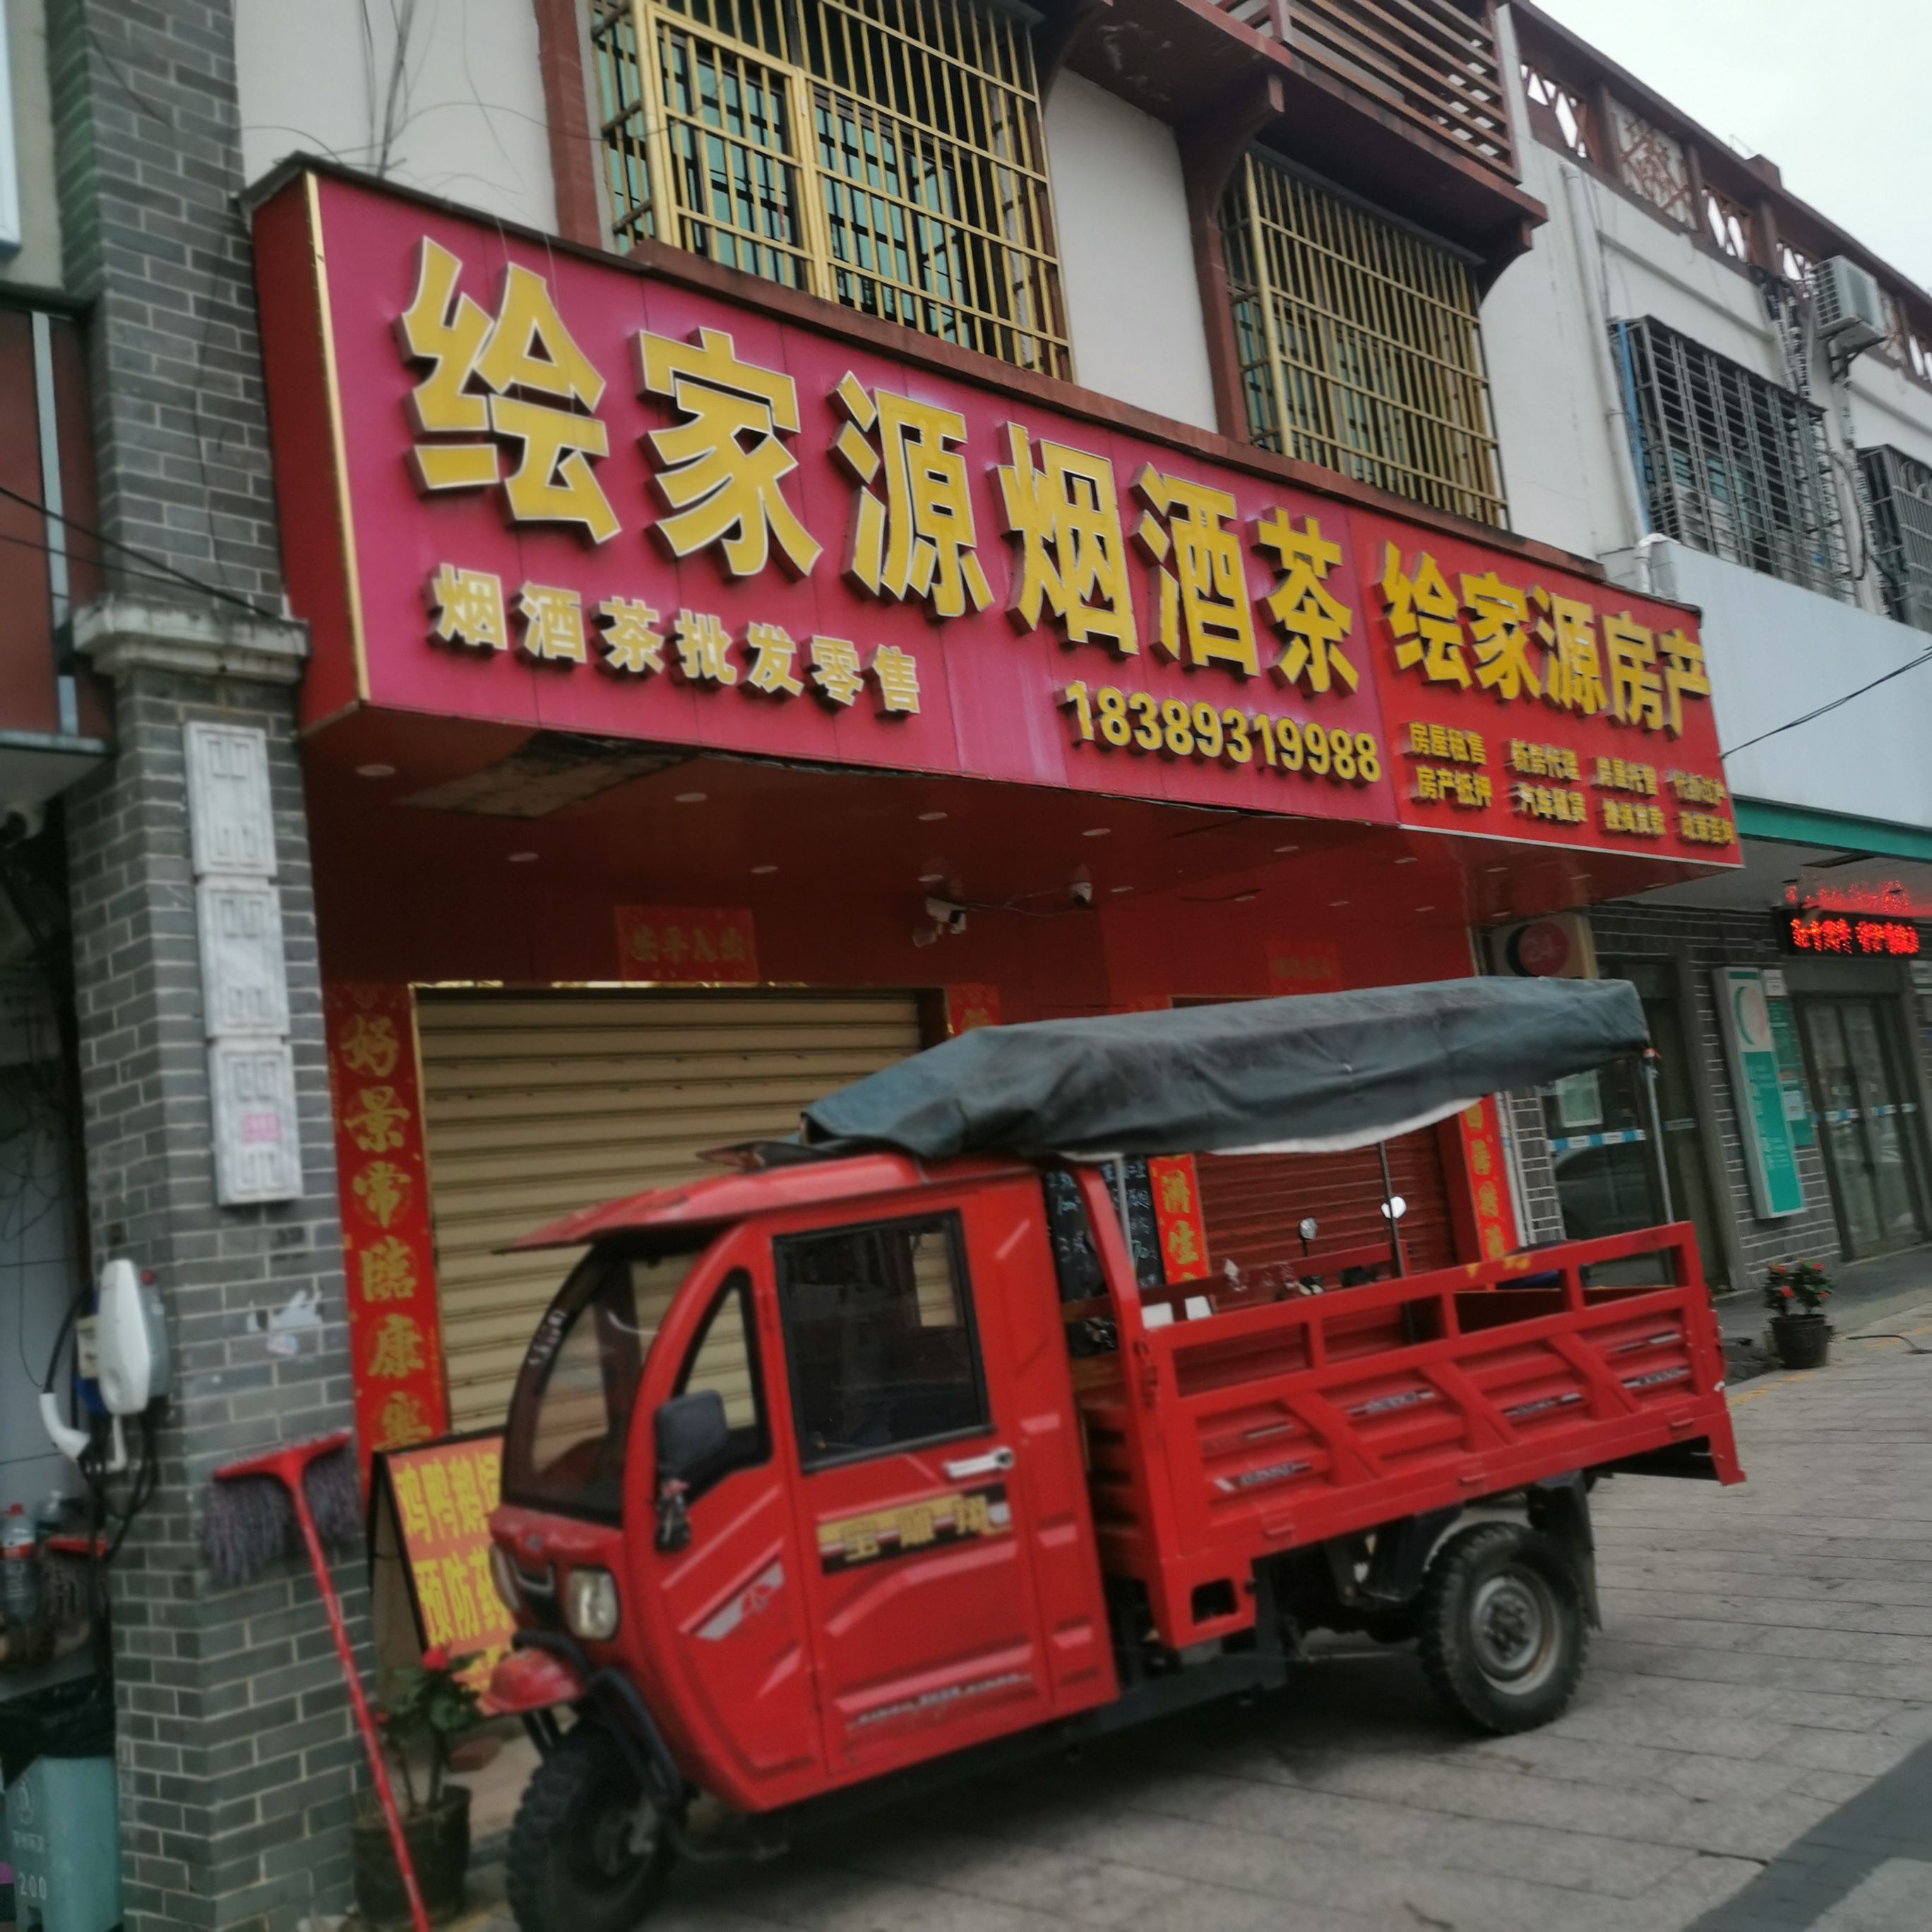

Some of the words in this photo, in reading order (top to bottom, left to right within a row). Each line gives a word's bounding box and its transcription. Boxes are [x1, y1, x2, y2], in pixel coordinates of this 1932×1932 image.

[398, 235, 1360, 693] 绘家源烟酒茶
[429, 563, 921, 715] 烟酒茶批发零售
[1377, 539, 1710, 738] 绘家源房产
[1063, 680, 1381, 783] 18389319988
[1409, 721, 1487, 765] 房屋租售
